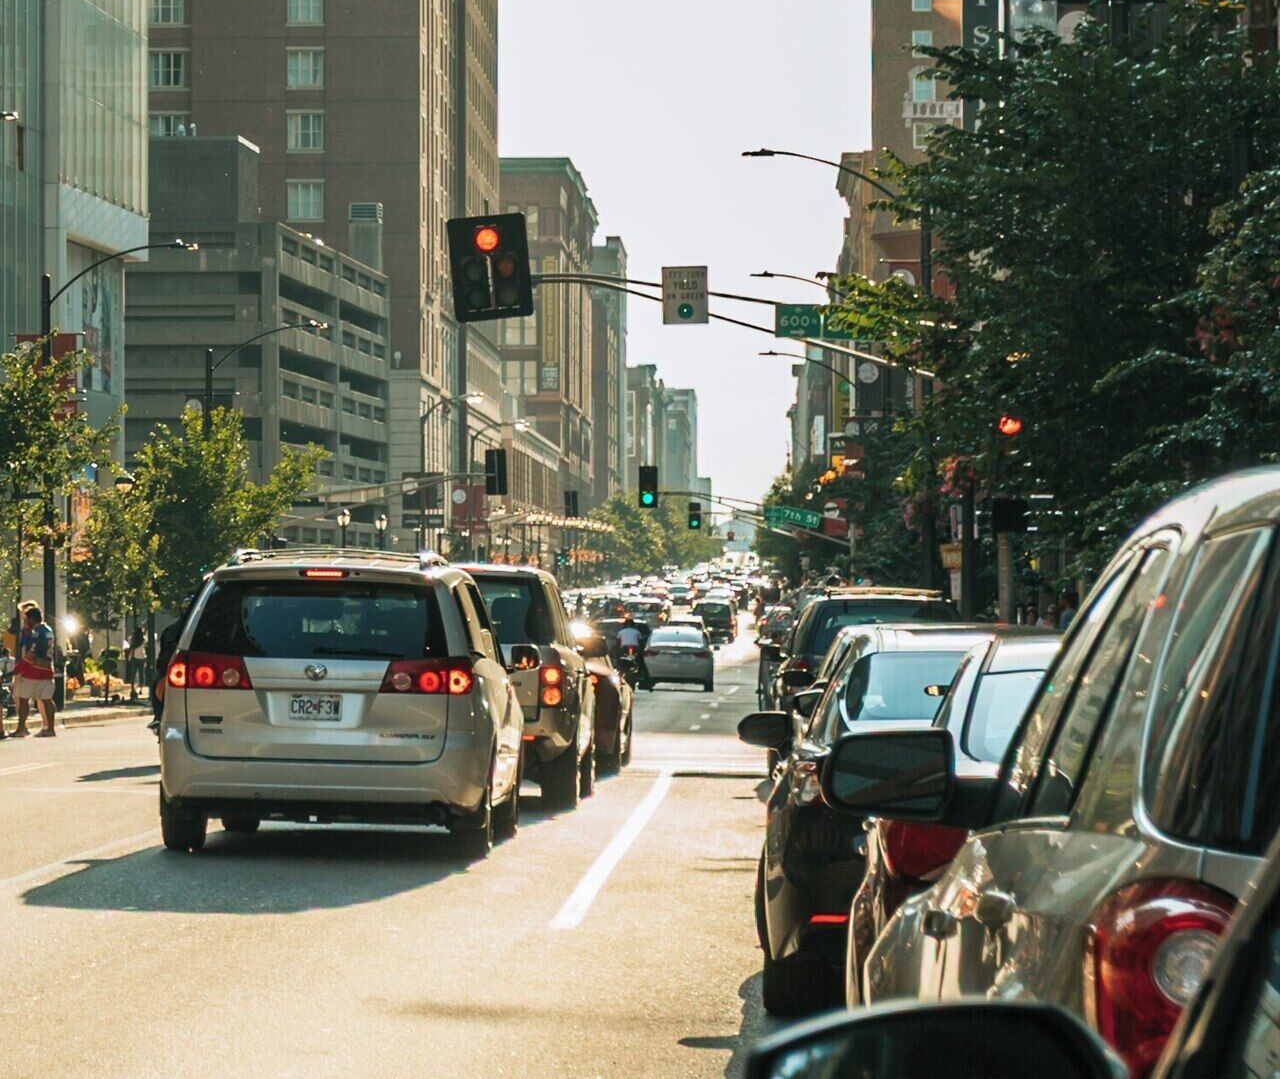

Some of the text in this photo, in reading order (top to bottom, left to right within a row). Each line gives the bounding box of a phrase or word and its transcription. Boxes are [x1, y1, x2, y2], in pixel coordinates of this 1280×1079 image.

[672, 281, 698, 290] YIELD
[680, 292, 704, 300] GREEN
[779, 315, 810, 327] 600
[784, 509, 801, 521] 7th
[806, 514, 818, 525] St
